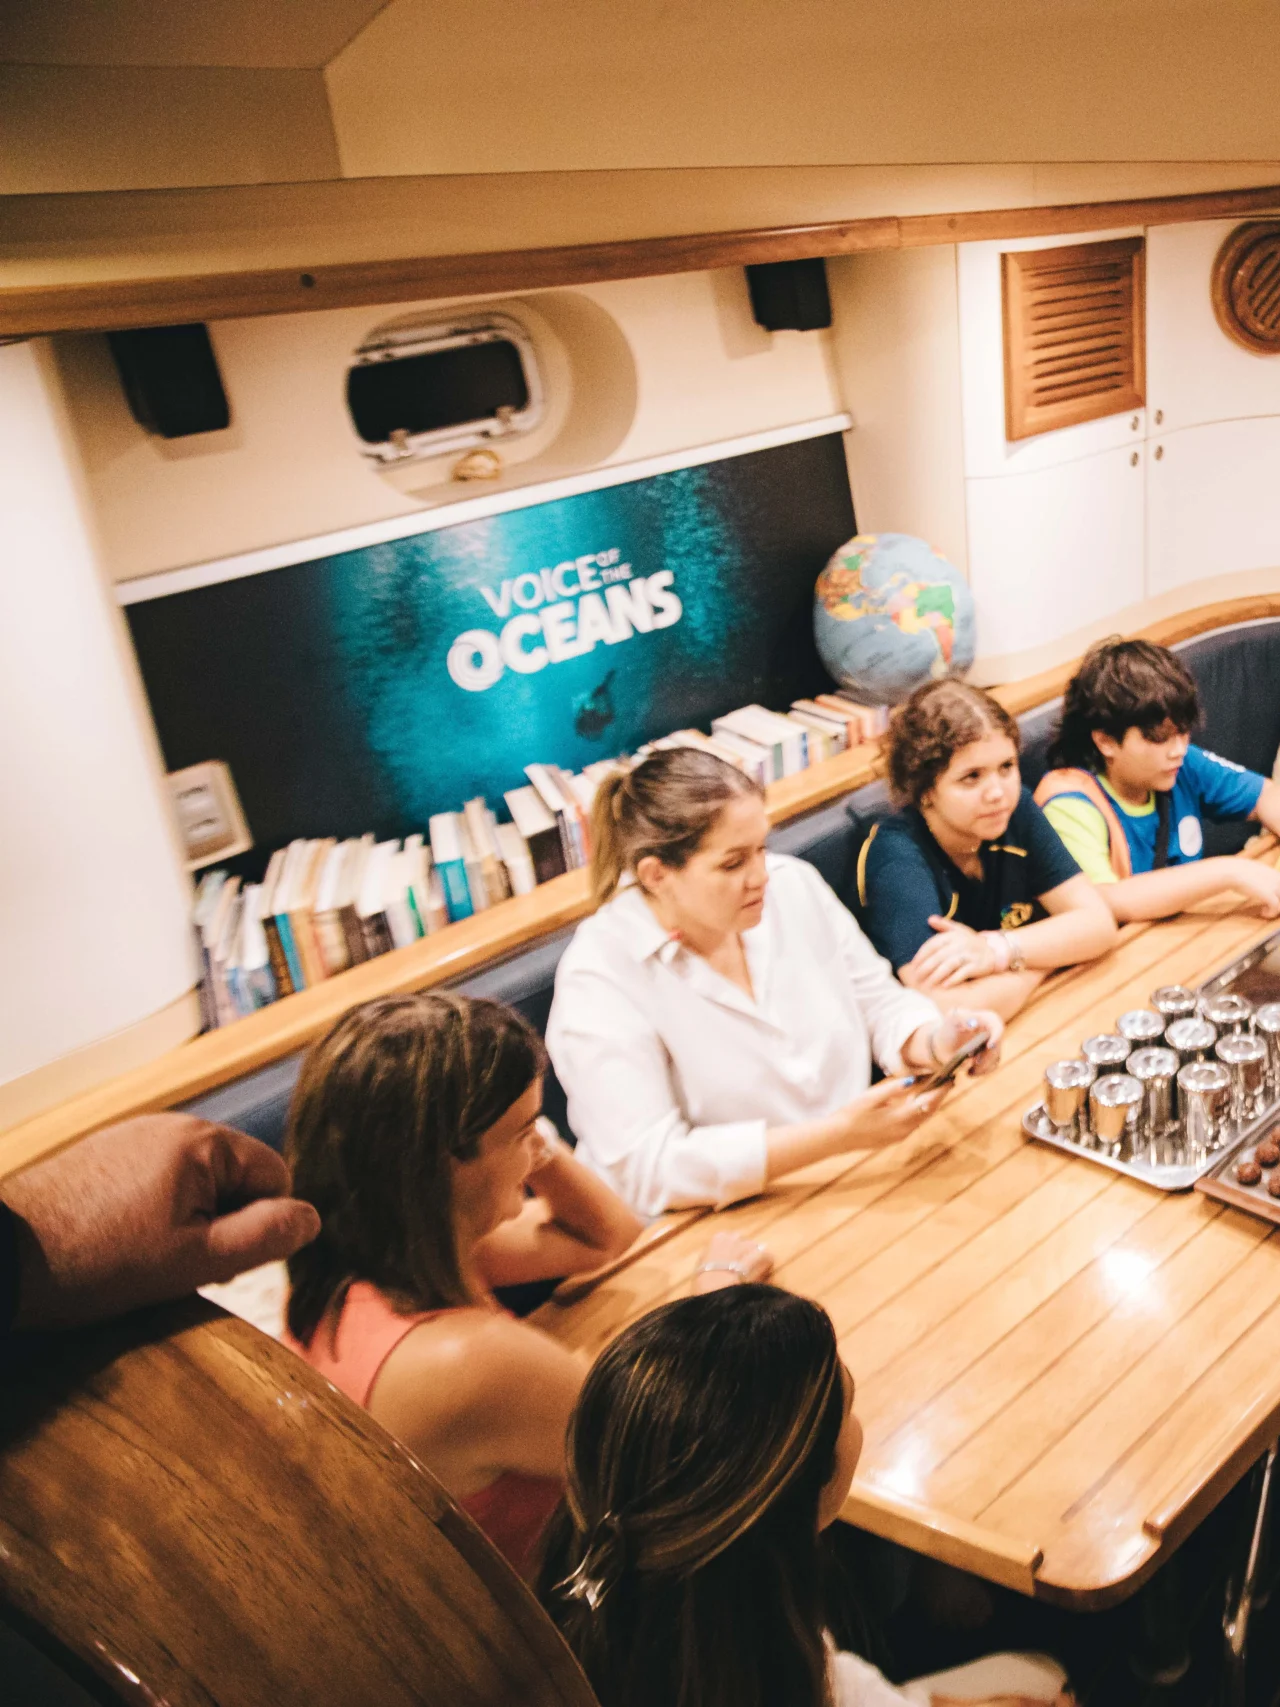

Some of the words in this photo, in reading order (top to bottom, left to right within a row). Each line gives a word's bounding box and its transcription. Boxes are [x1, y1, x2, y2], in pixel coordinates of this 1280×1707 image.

[596, 548, 620, 567] OF
[601, 563, 633, 584] THE
[480, 554, 601, 617] VOICE
[447, 570, 683, 692] OCEANS
